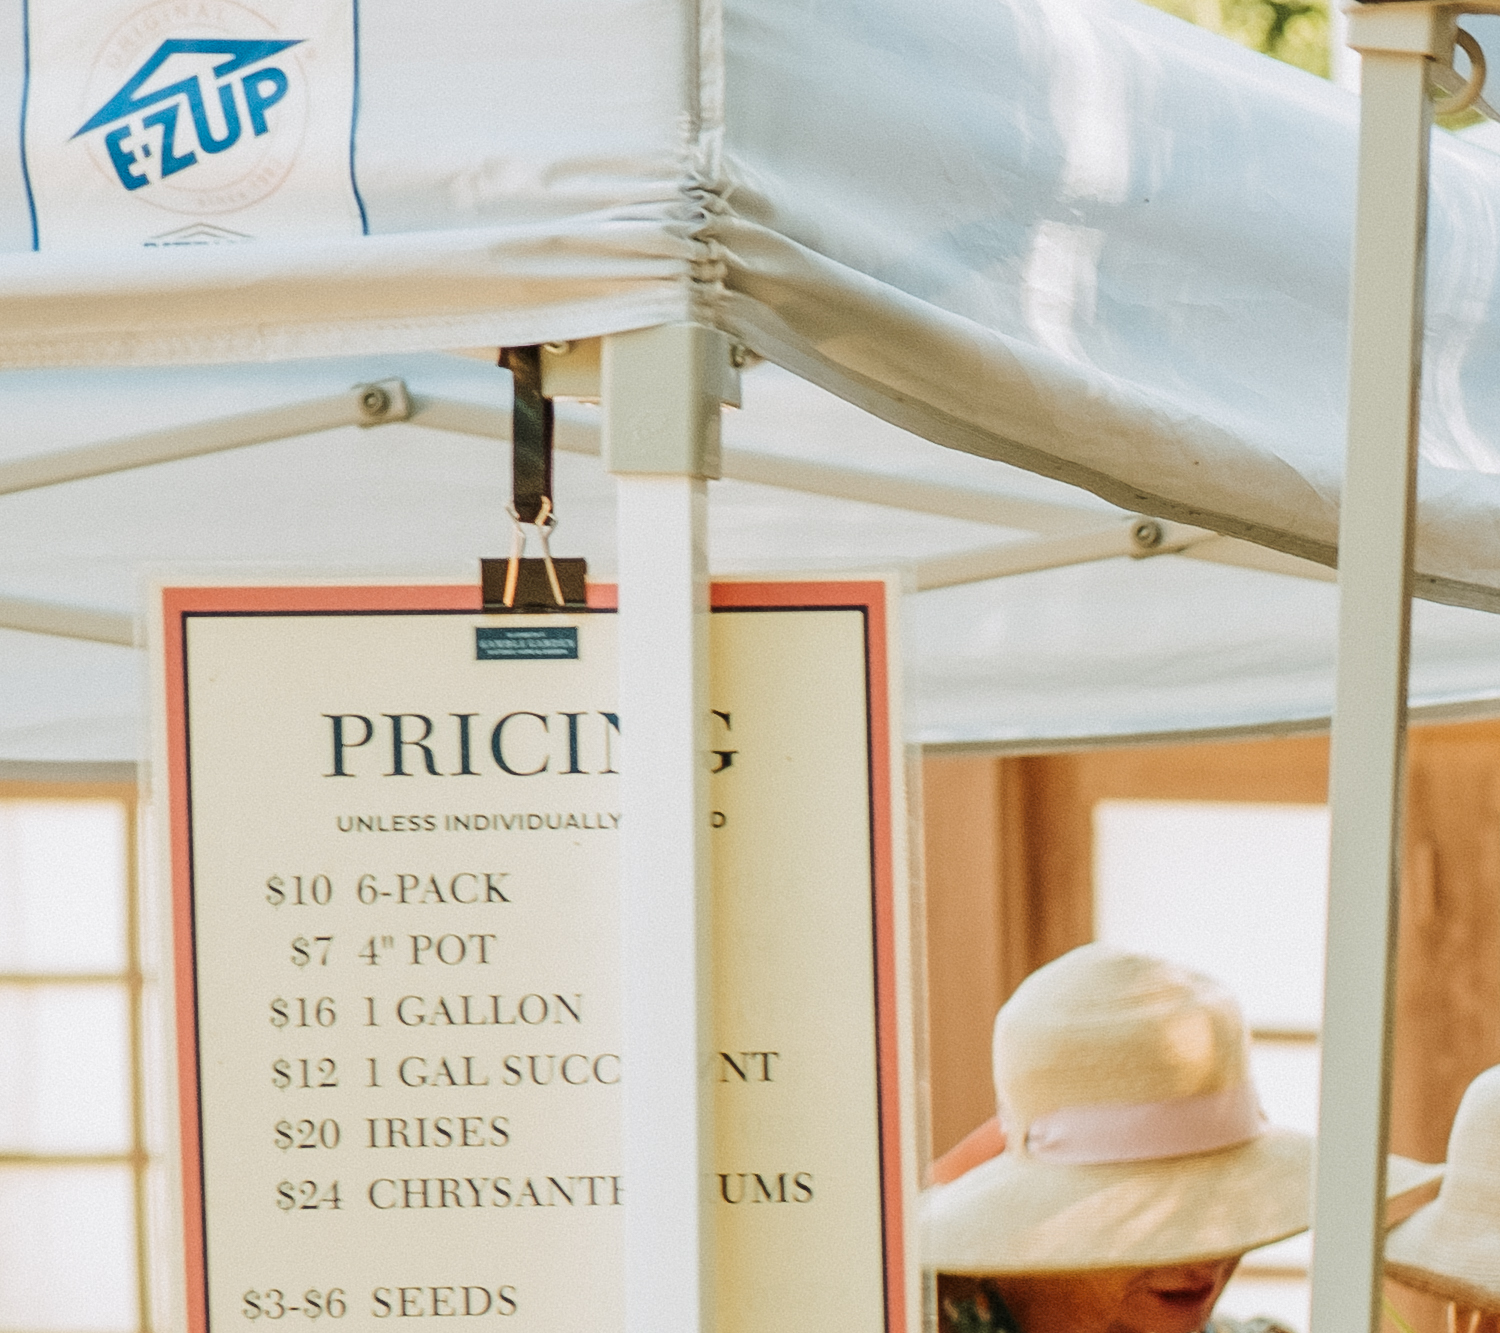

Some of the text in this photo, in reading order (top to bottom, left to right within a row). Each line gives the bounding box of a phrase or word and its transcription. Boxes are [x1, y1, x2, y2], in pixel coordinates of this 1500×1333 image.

[337, 813, 622, 833] UNLESS INDIVIDUALLY
[266, 872, 512, 908] $10 6-PACK
[290, 933, 497, 969] $7 4" POT
[270, 993, 583, 1030] $16 1 GALLON
[271, 1051, 779, 1091] $12 1 GAL SUCCNT
[274, 1115, 511, 1153] $20 IRISES
[276, 1172, 814, 1213] $24 CHRYSANTUMS
[242, 1285, 519, 1323] $3-$6 SEEDS
